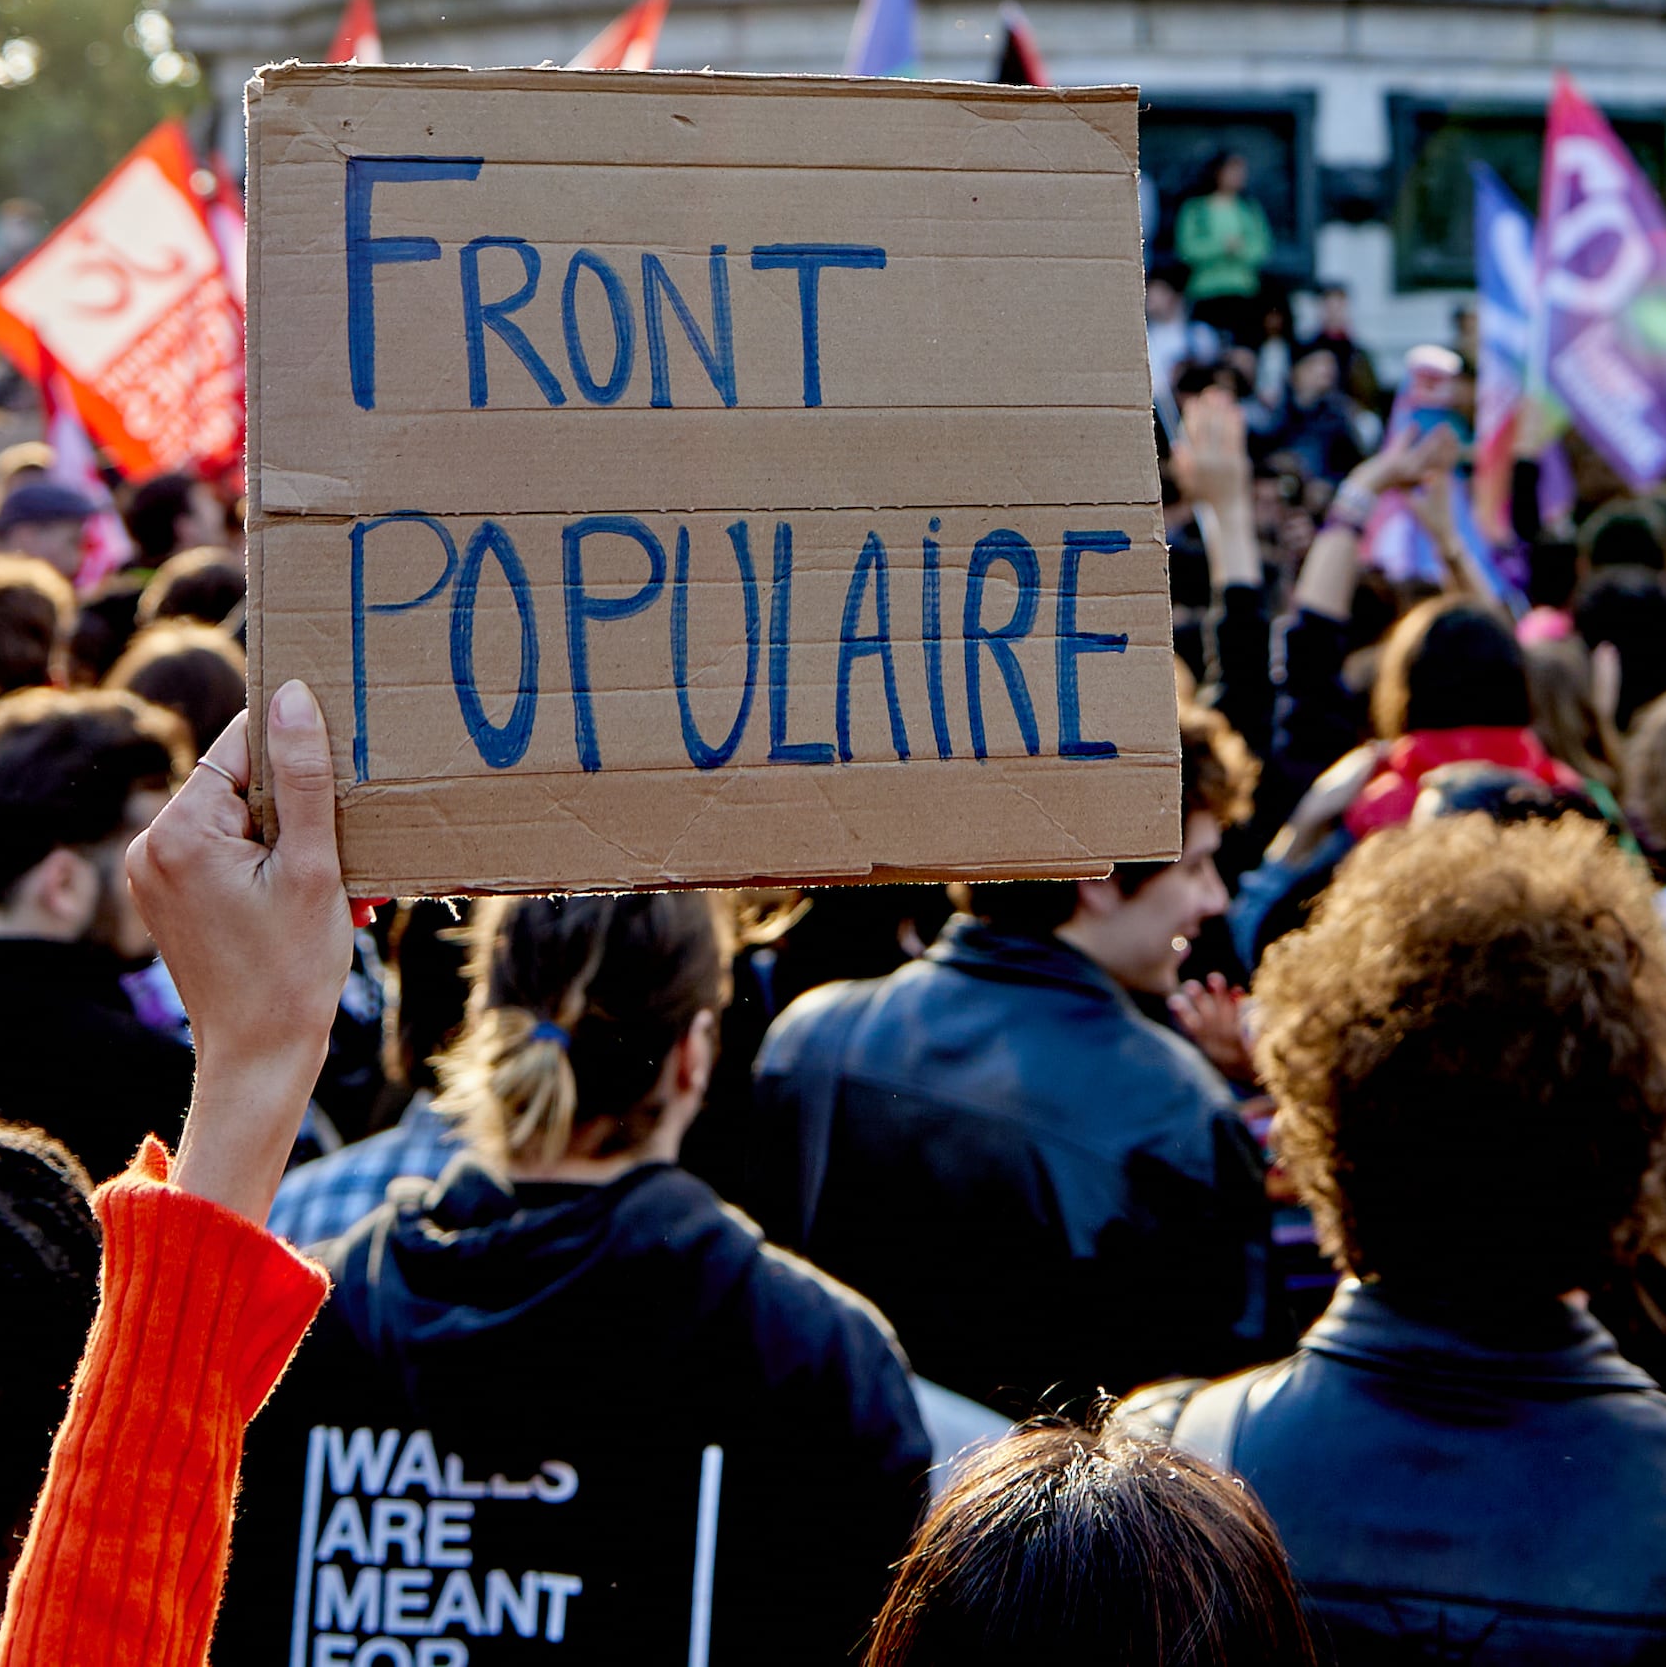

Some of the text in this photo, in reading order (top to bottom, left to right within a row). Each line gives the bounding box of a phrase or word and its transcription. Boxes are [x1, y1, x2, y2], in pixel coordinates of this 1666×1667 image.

[344, 155, 887, 410] FRONT
[348, 509, 1132, 783] POPULAIRE
[313, 1564, 583, 1645] MEANT
[316, 1496, 476, 1567] ARE
